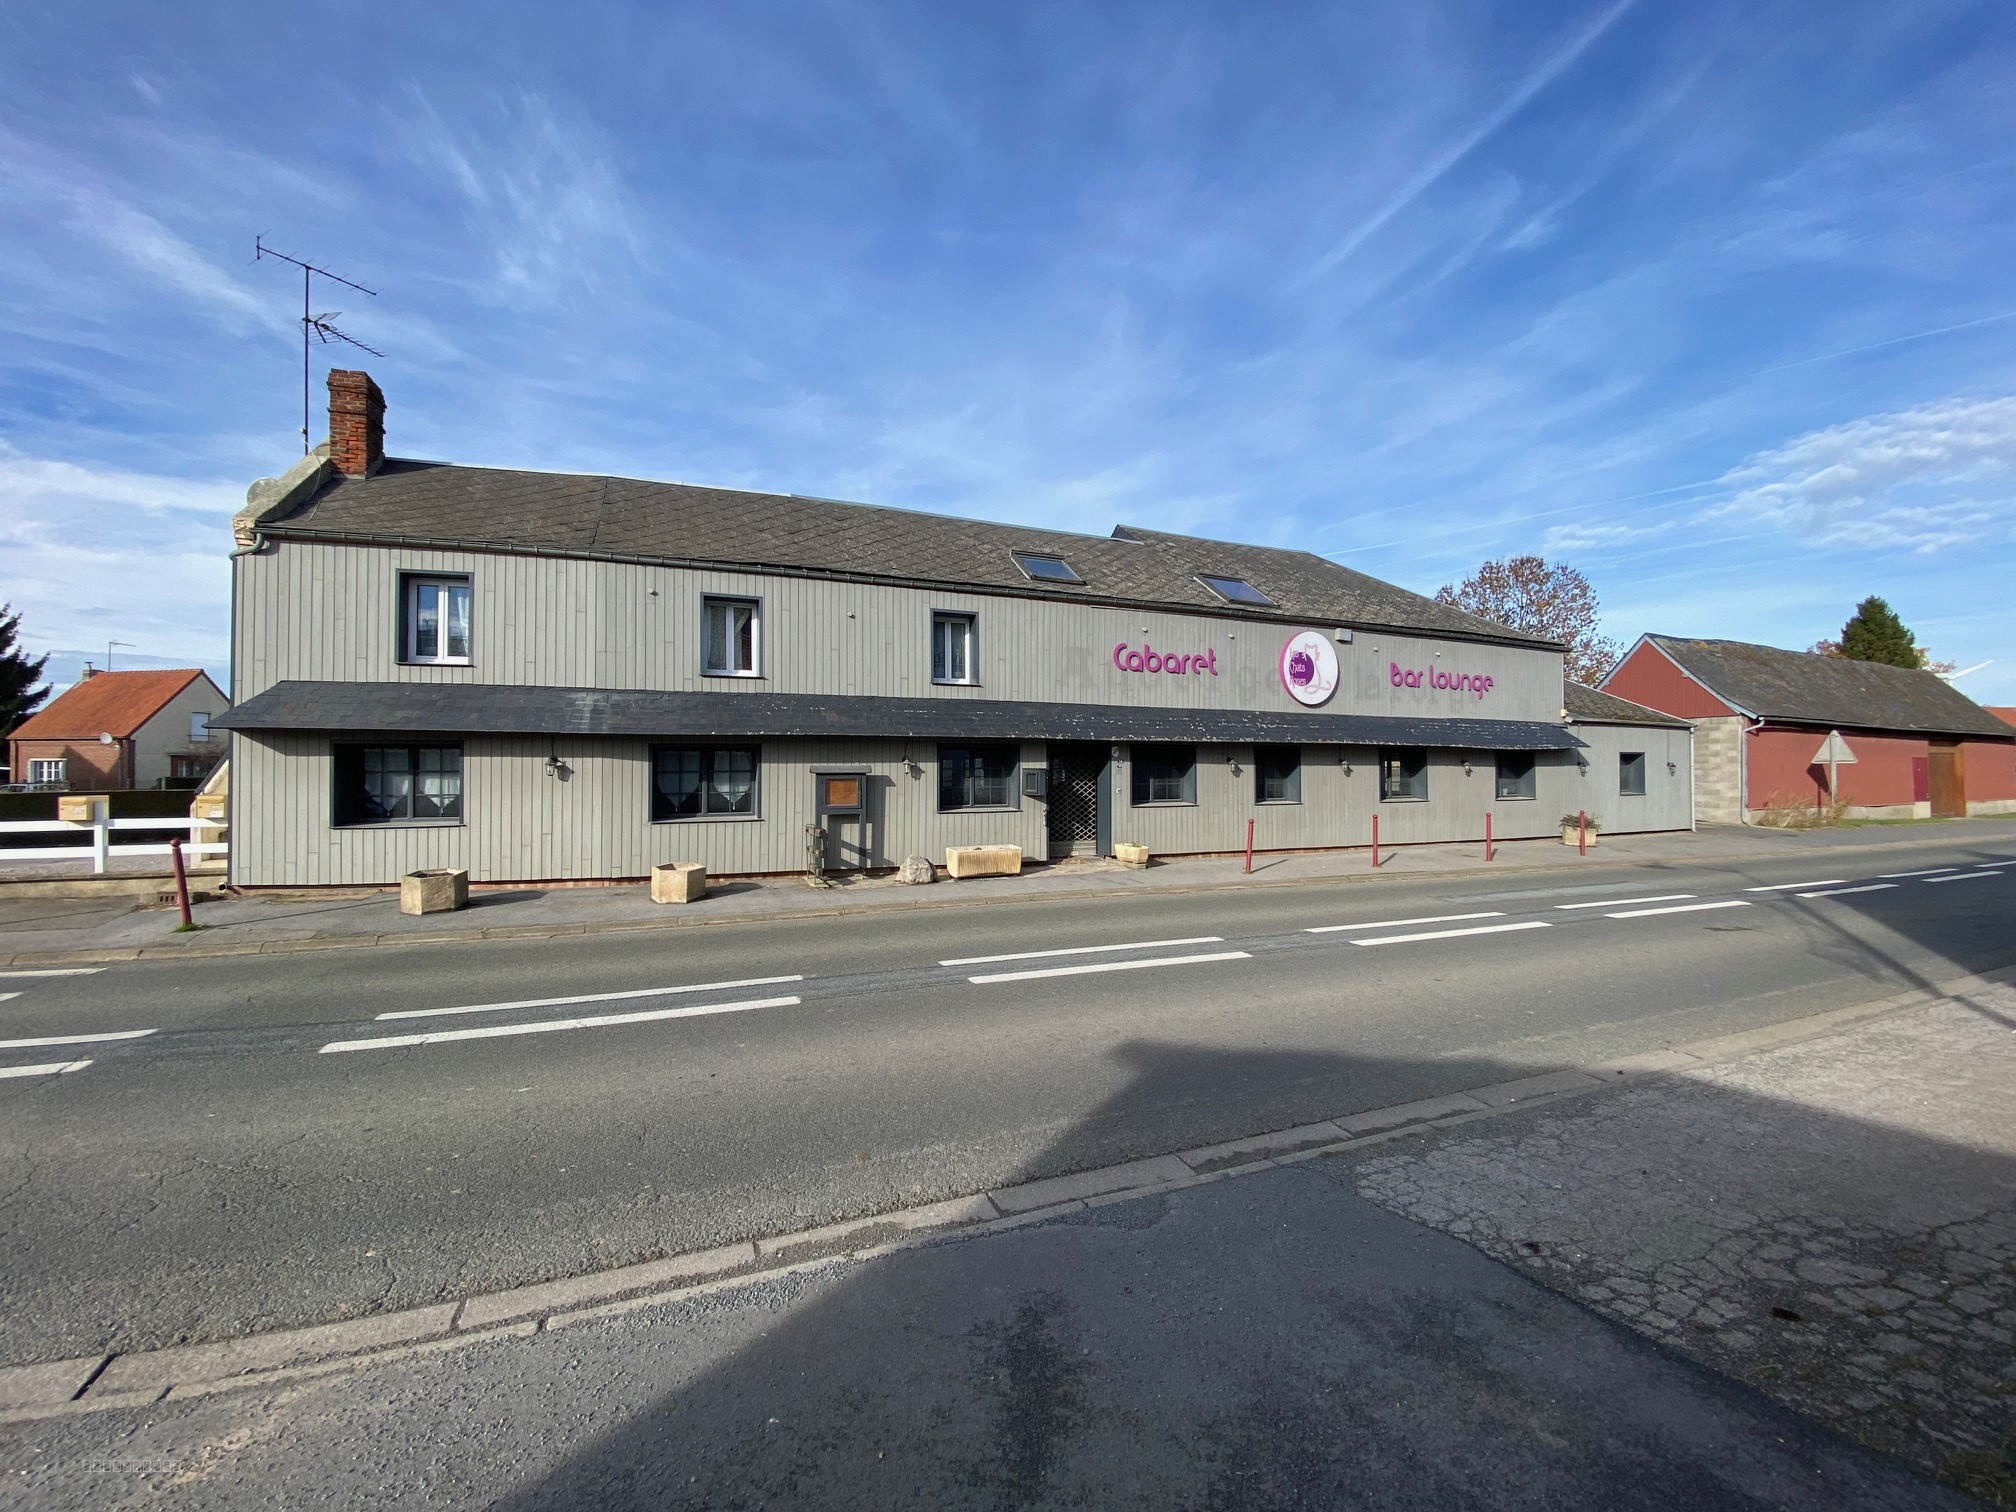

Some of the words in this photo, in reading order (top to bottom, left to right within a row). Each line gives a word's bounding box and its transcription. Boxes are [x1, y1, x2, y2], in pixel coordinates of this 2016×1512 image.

[1113, 642, 1218, 676] Cabaret
[1289, 661, 1306, 674] Chats
[1429, 664, 1494, 700] lounge
